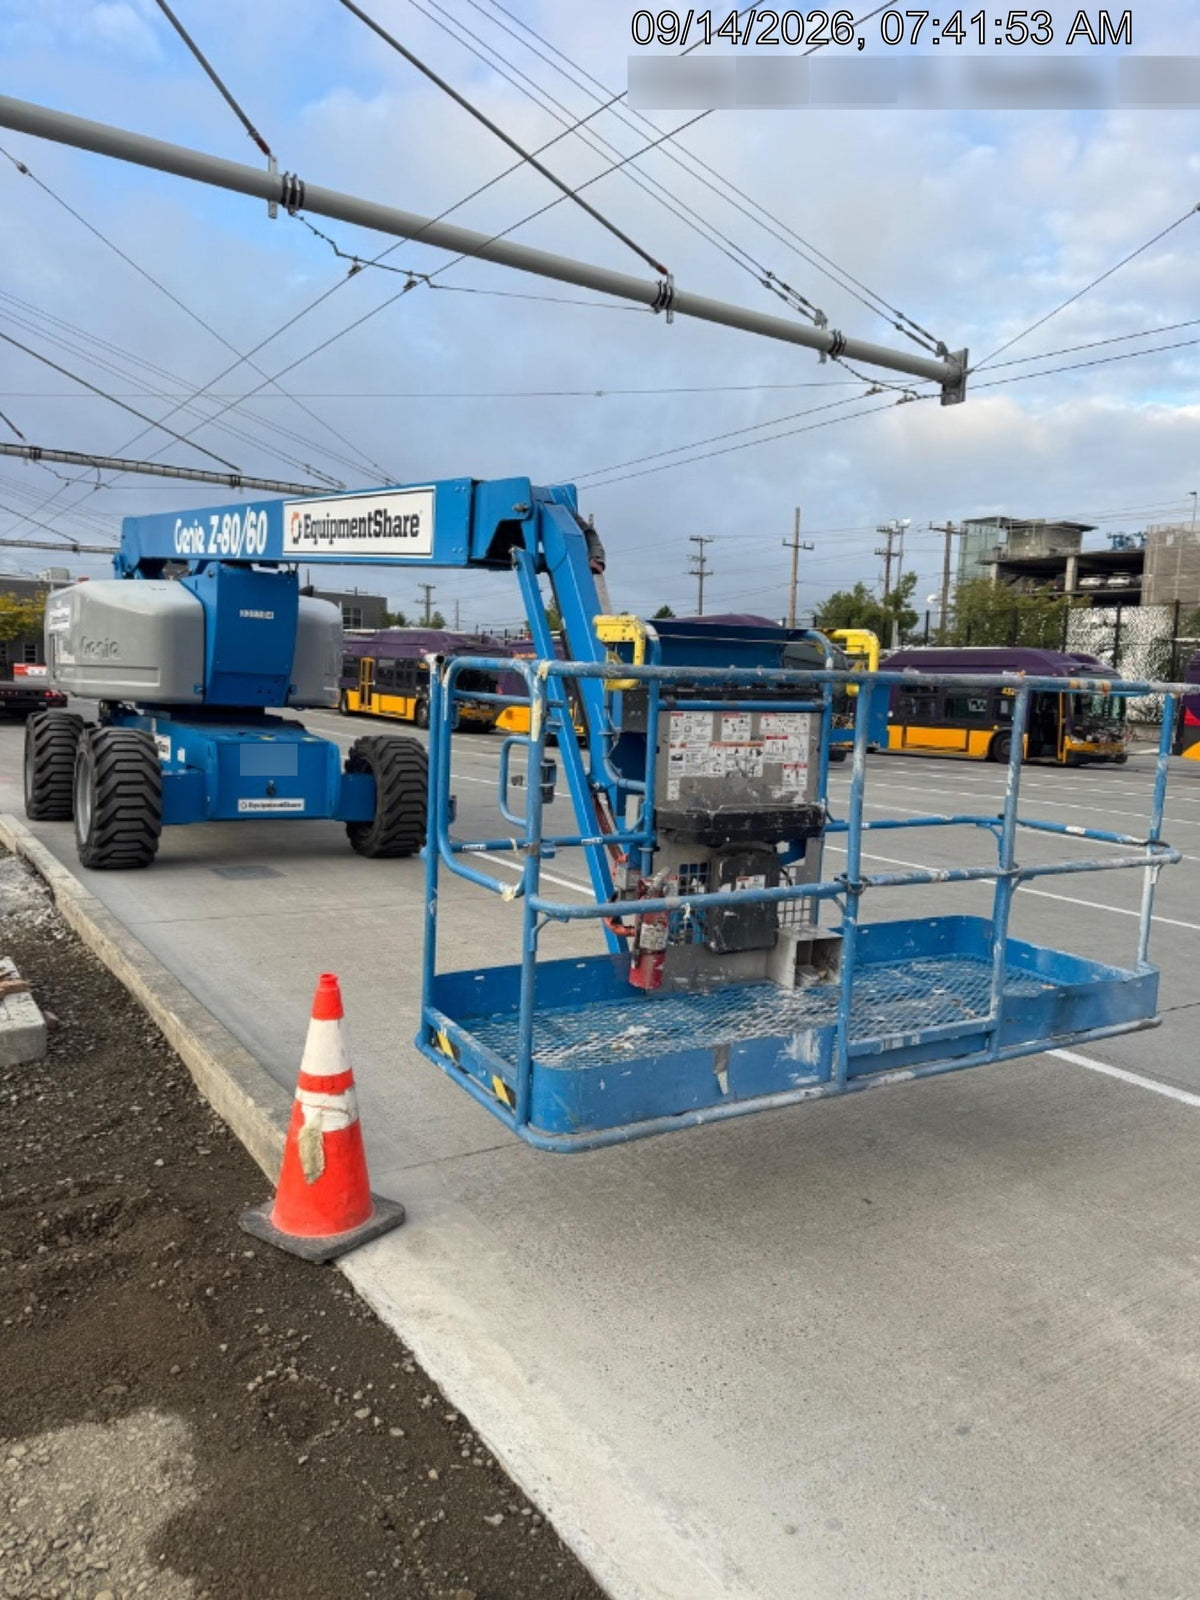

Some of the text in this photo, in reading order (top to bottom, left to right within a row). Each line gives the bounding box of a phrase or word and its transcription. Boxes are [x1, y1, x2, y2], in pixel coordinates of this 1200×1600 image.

[174, 506, 268, 558] Genie Z-80/60
[303, 508, 420, 545] EquipmentShare
